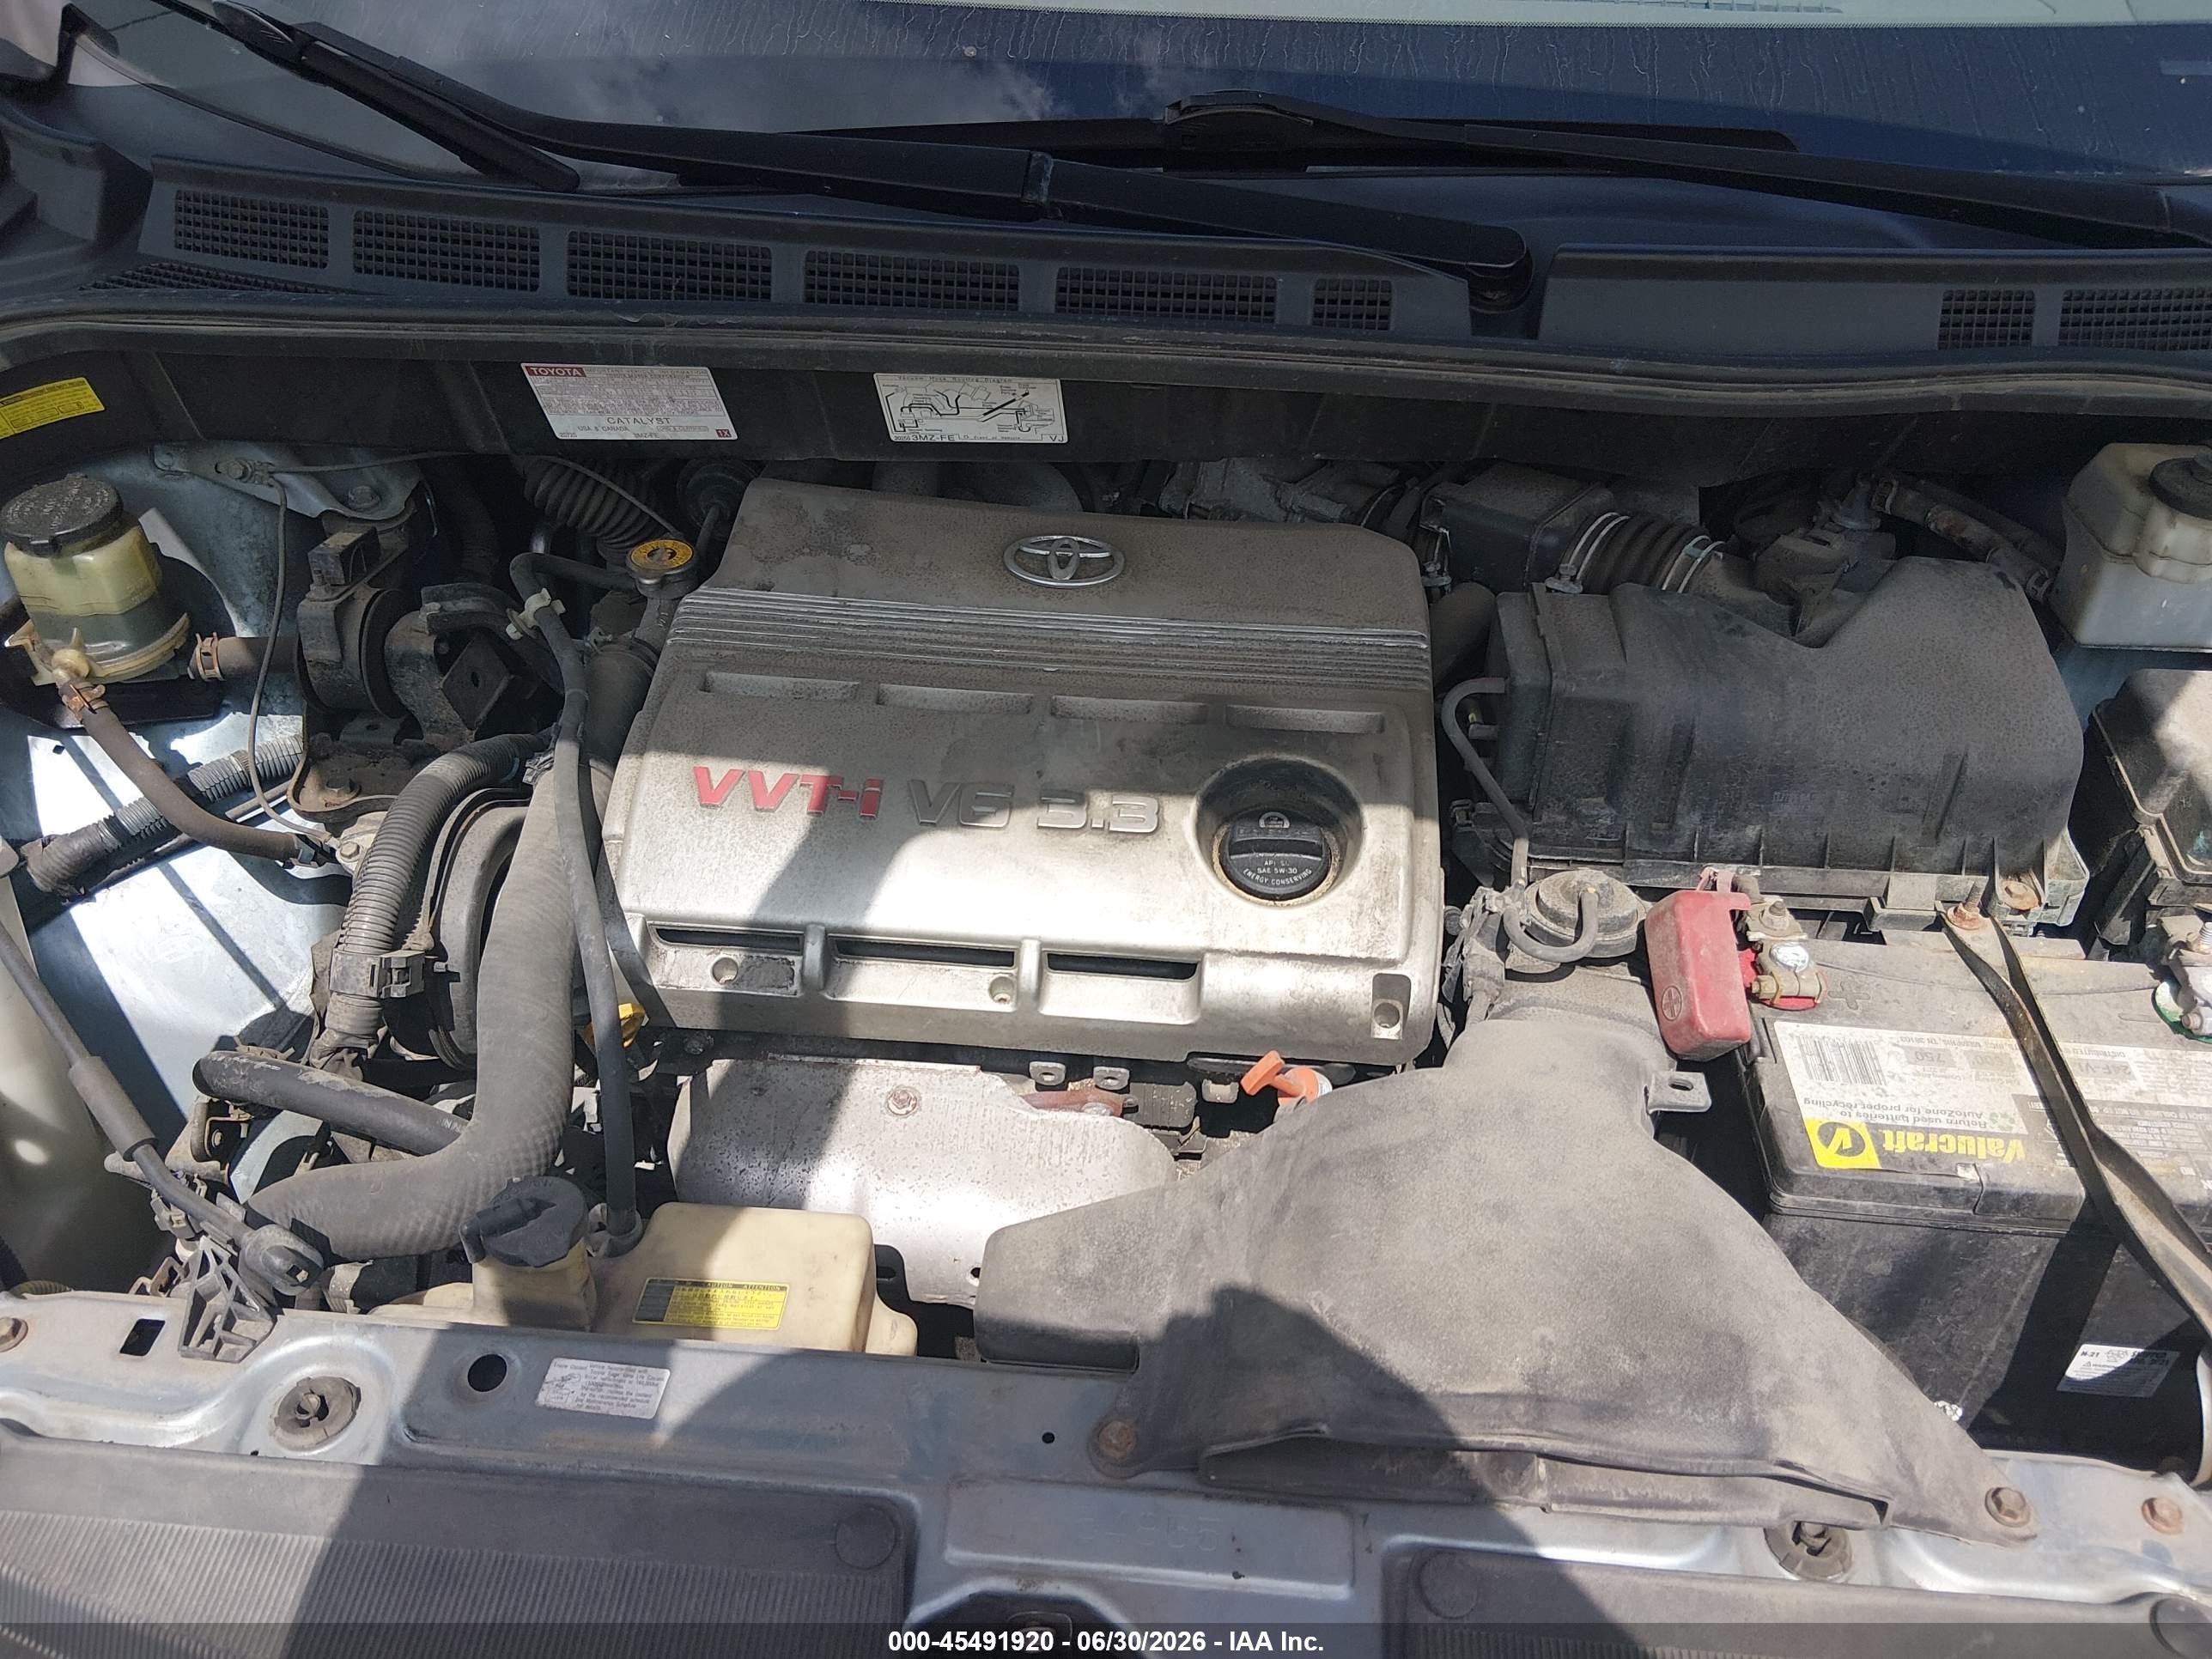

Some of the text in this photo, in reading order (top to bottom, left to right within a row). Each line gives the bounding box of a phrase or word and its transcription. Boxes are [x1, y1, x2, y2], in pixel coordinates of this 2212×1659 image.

[530, 367, 583, 377] TOYOTA
[606, 416, 672, 426] CATALYST
[692, 765, 1160, 835] VVT-i V6 3.3
[1243, 868, 1312, 885] ENERGY CONSERVING
[1915, 1050, 1945, 1064] 750
[1803, 1097, 1984, 1120] AutoZone for proper recycling
[1839, 1110, 1988, 1129] Return used batteries to
[1880, 1129, 2027, 1164] Valucraft
